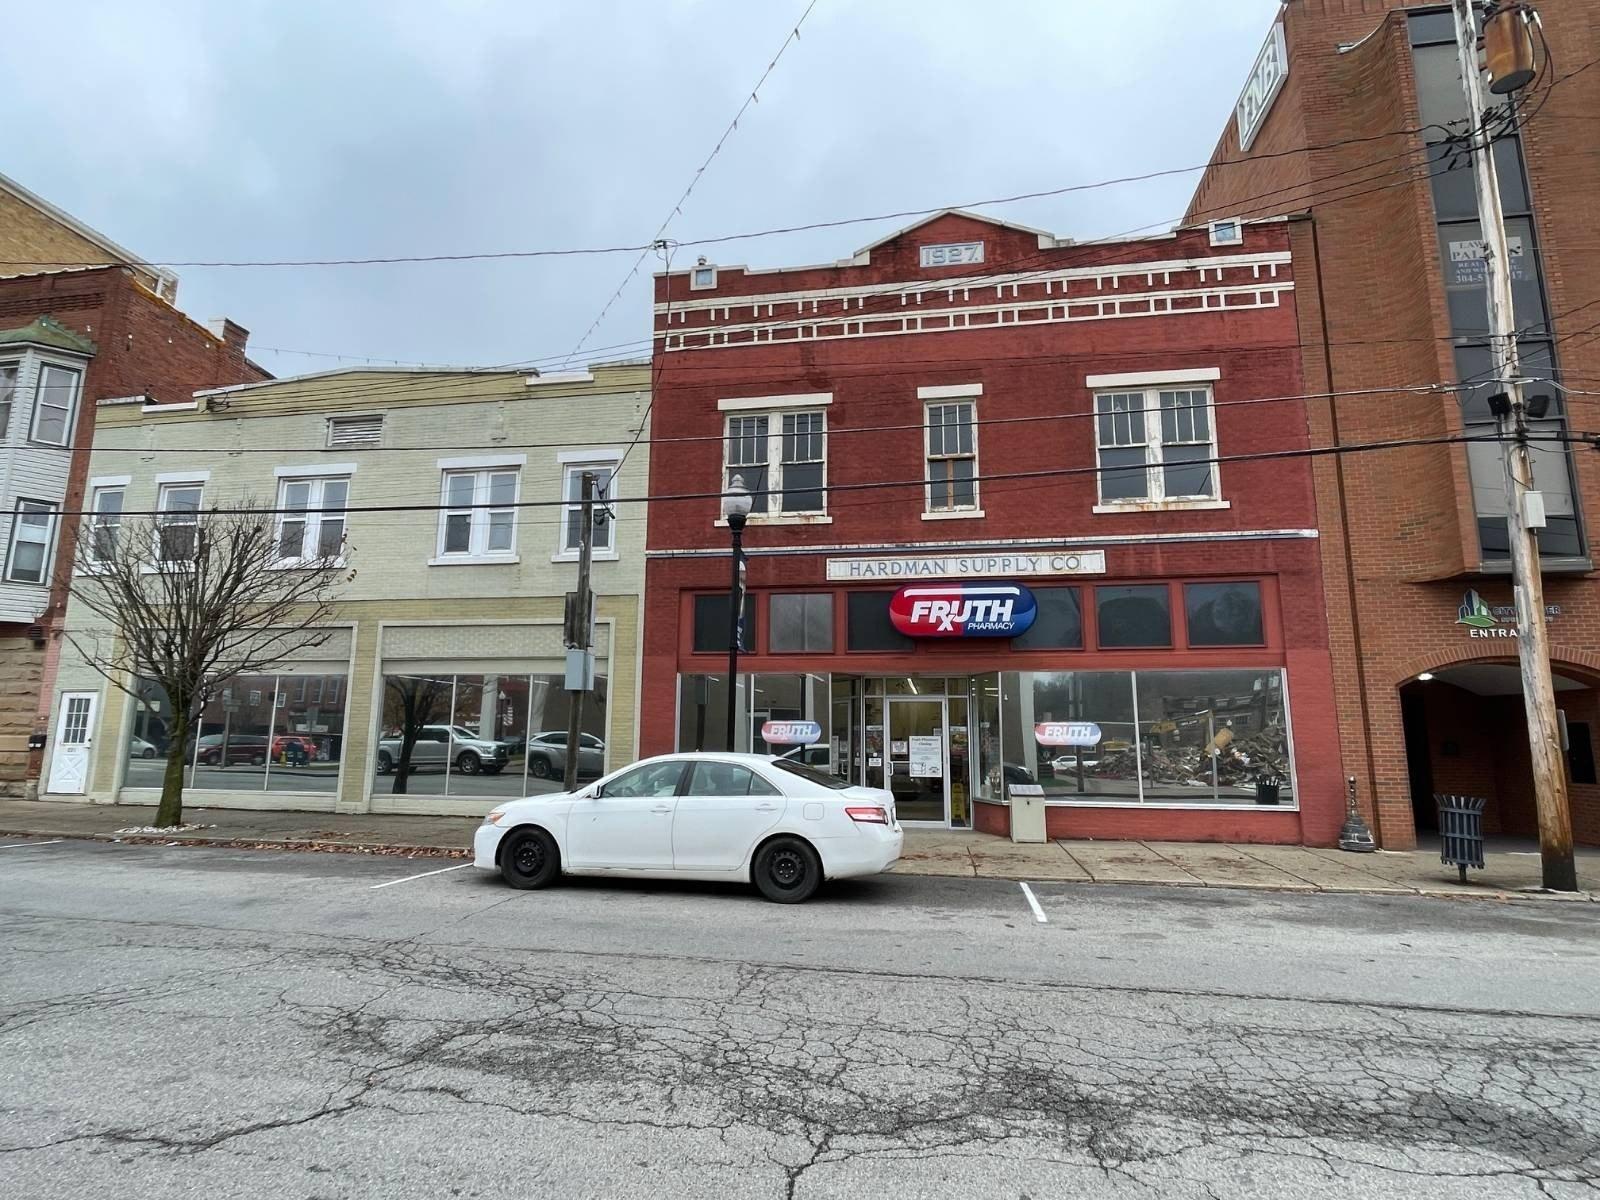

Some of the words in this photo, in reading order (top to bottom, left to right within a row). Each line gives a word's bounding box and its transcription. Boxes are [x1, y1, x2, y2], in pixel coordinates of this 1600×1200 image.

[849, 560, 946, 577] HARDMAN
[959, 556, 1041, 573] SUPPLY
[967, 622, 1015, 630] PHARMACY
[1470, 628, 1517, 638] ENTRA
[769, 724, 813, 736] FRUTH
[1044, 726, 1092, 738] FRUTH
